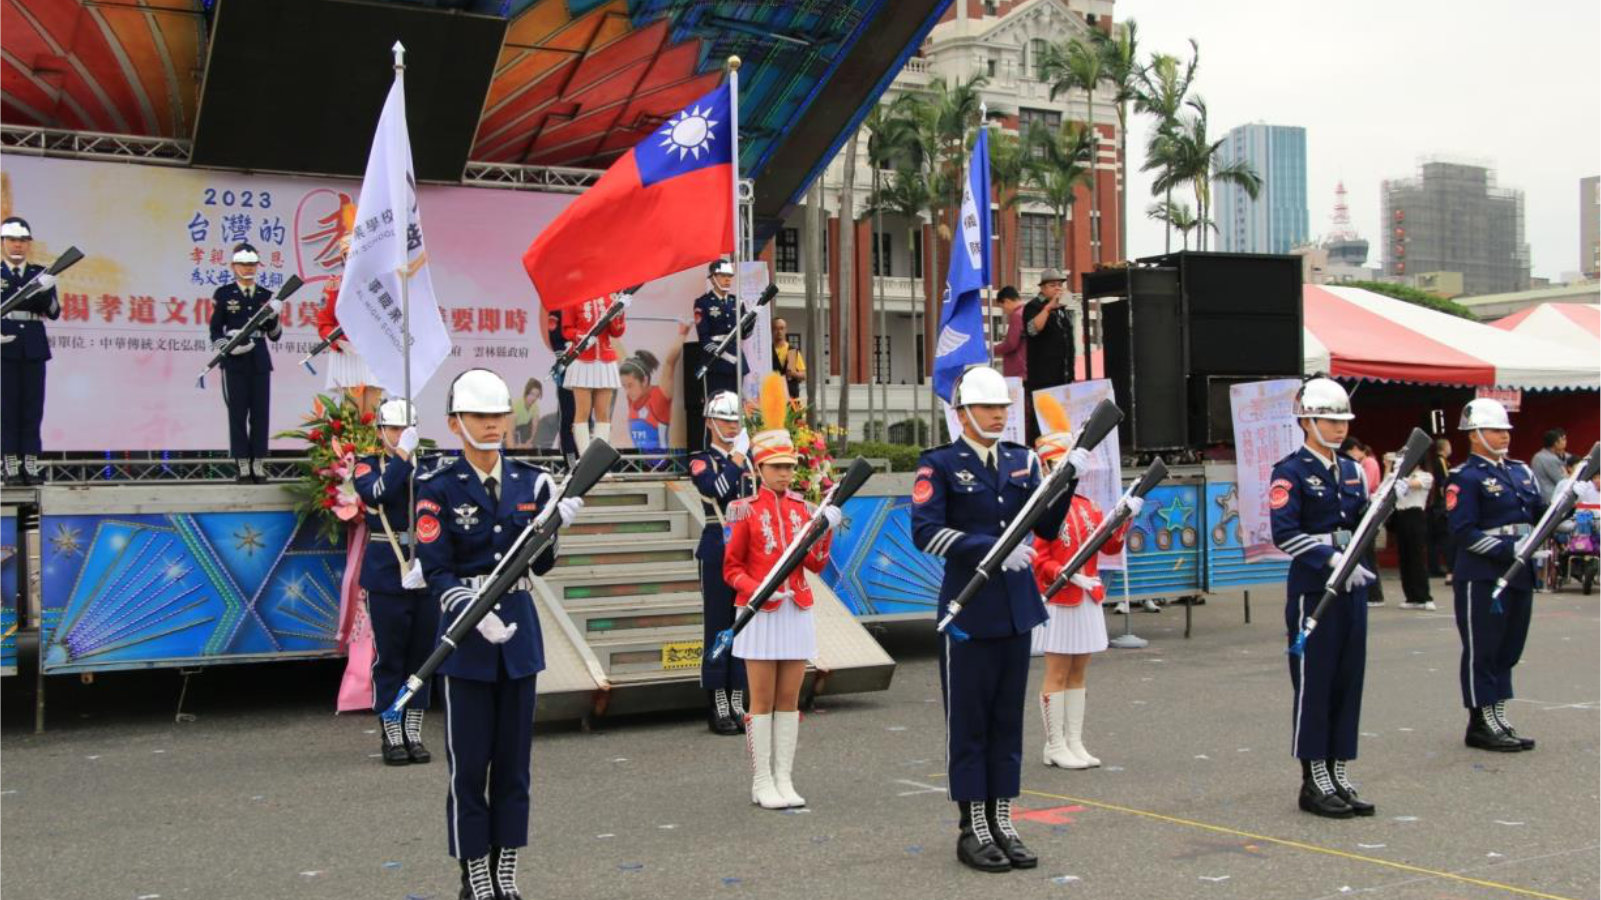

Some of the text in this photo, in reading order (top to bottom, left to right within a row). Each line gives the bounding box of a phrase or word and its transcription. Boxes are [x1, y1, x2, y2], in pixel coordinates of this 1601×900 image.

[204, 188, 272, 209] 2023
[188, 212, 285, 245] 台灣的
[381, 322, 404, 353] SCHOO
